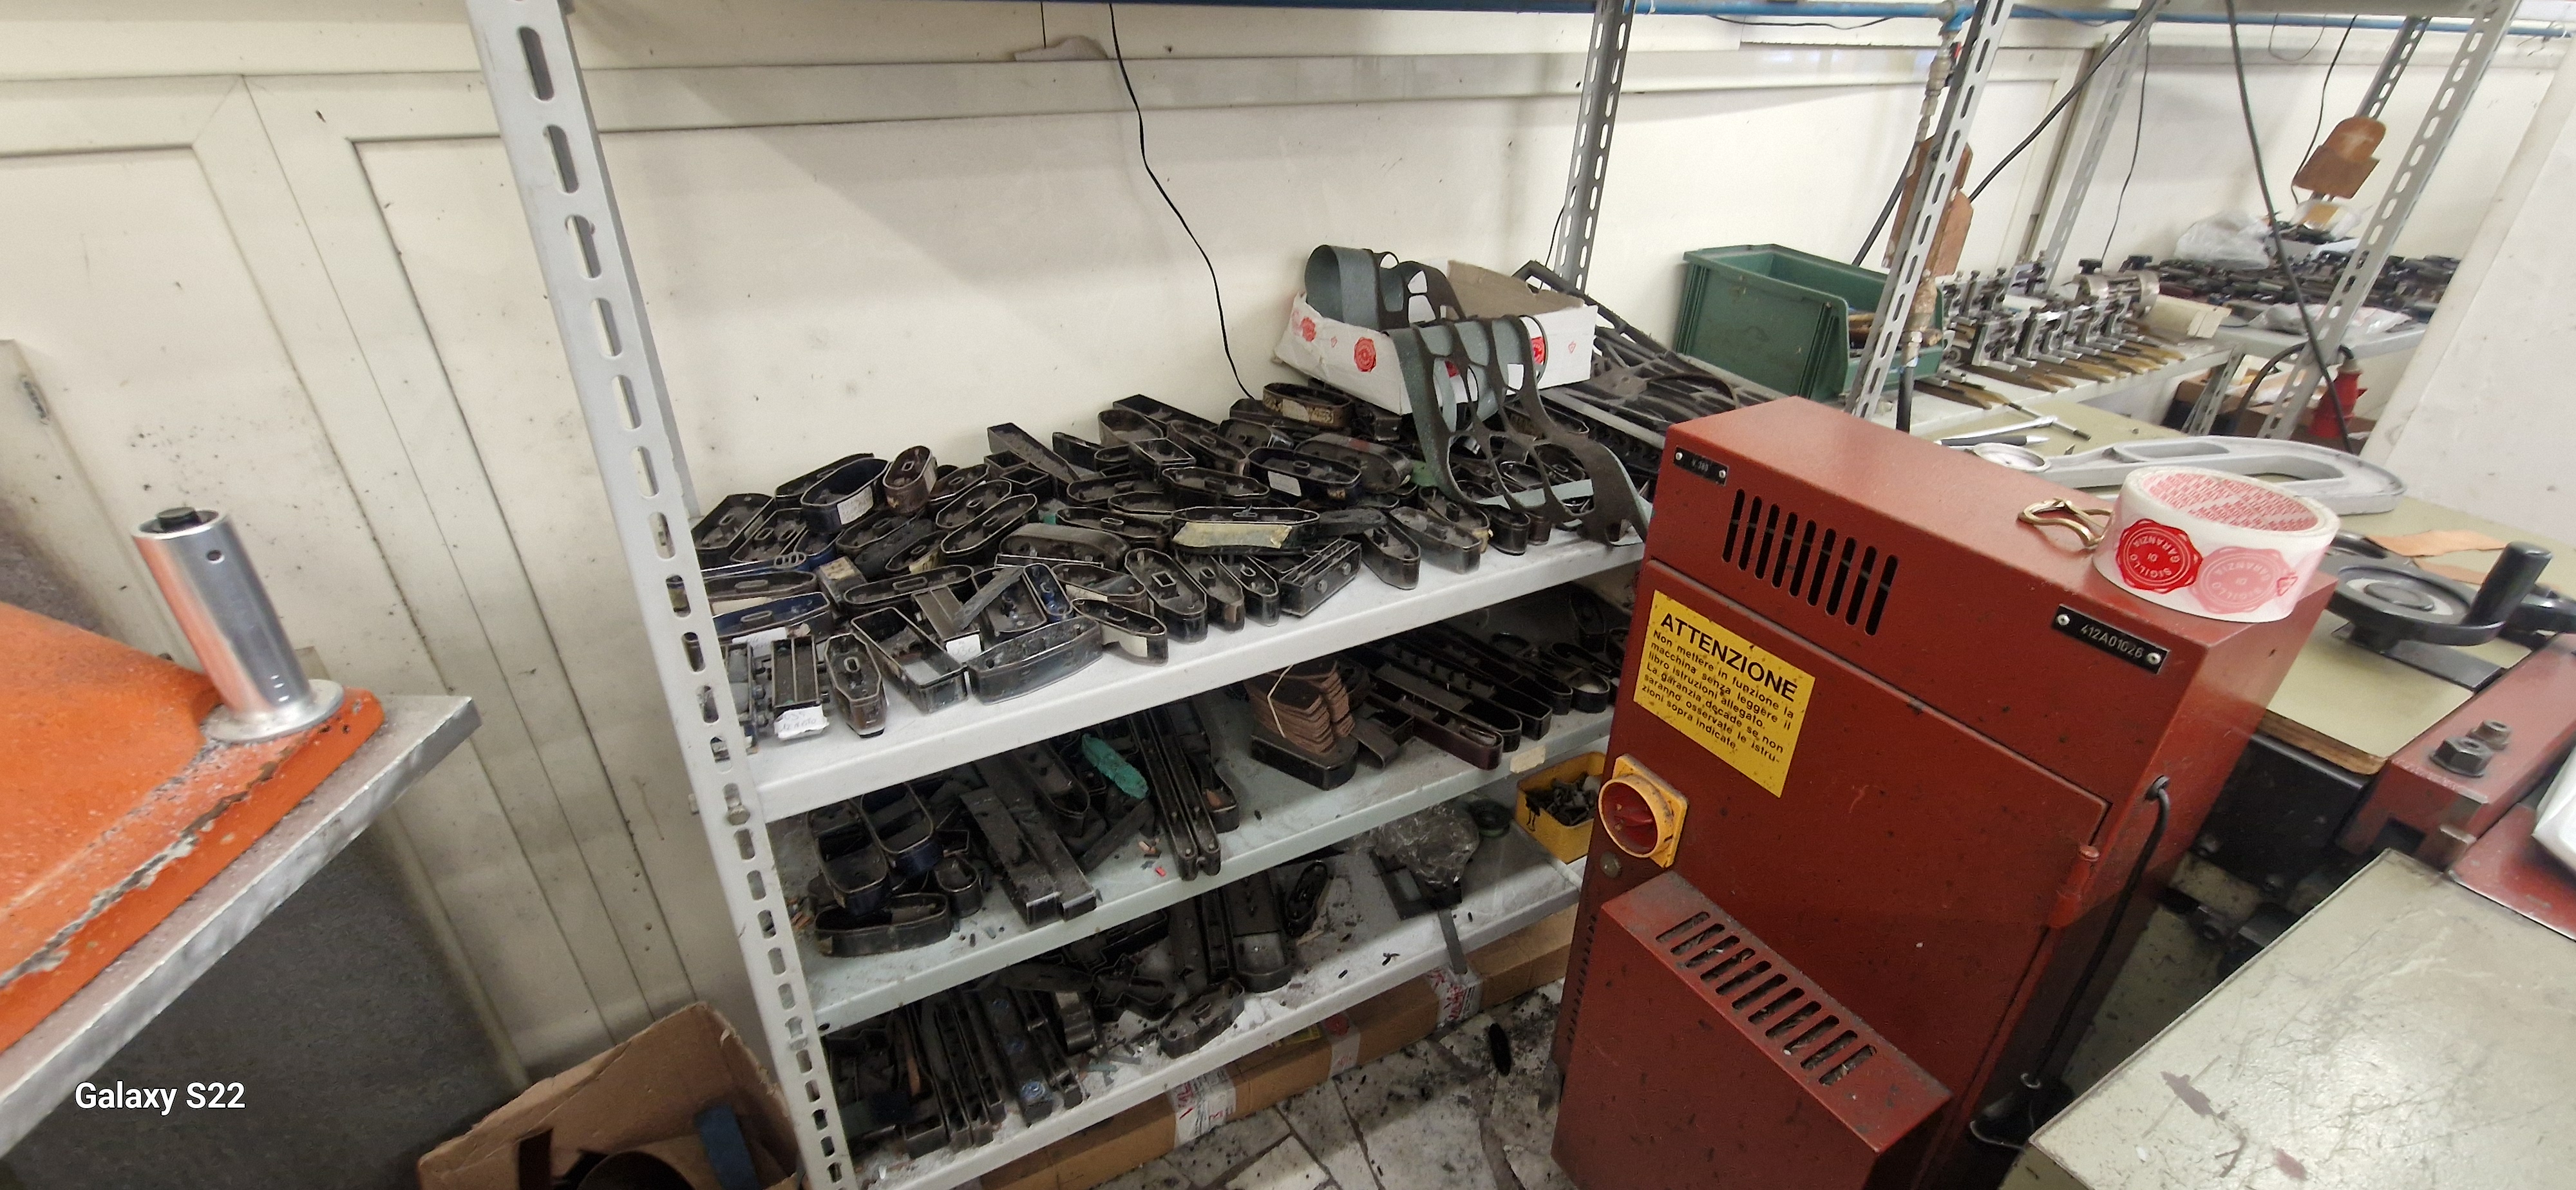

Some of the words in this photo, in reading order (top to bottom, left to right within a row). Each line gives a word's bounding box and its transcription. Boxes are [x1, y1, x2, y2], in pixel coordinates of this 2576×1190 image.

[2130, 554, 2172, 578] SIGILLO
[2132, 535, 2181, 563] GARANZIA
[1649, 652, 1669, 669] libro
[1673, 668, 1717, 699] istruzioni
[1651, 643, 1696, 674] macchina
[1702, 674, 1731, 694] senza
[1738, 693, 1777, 722] leggere
[1785, 721, 1790, 730] il
[1654, 630, 1672, 646] Non
[1678, 646, 1714, 671] mettere
[1719, 668, 1728, 680] in
[1733, 677, 1779, 710] funzione
[1785, 706, 1794, 719] la
[1660, 614, 1797, 702] ATTENZIONE
[1642, 686, 1663, 703] zioni
[1667, 701, 1692, 721] sopra
[1645, 675, 1681, 701] saranno
[1686, 701, 1732, 733] osservate
[1738, 732, 1747, 742] le
[1752, 742, 1779, 762] istru-
[1647, 663, 1657, 674] La
[1662, 672, 1701, 702] garanzia
[1706, 701, 1742, 727] decade
[1747, 728, 1758, 737] se
[1763, 737, 1783, 753] non
